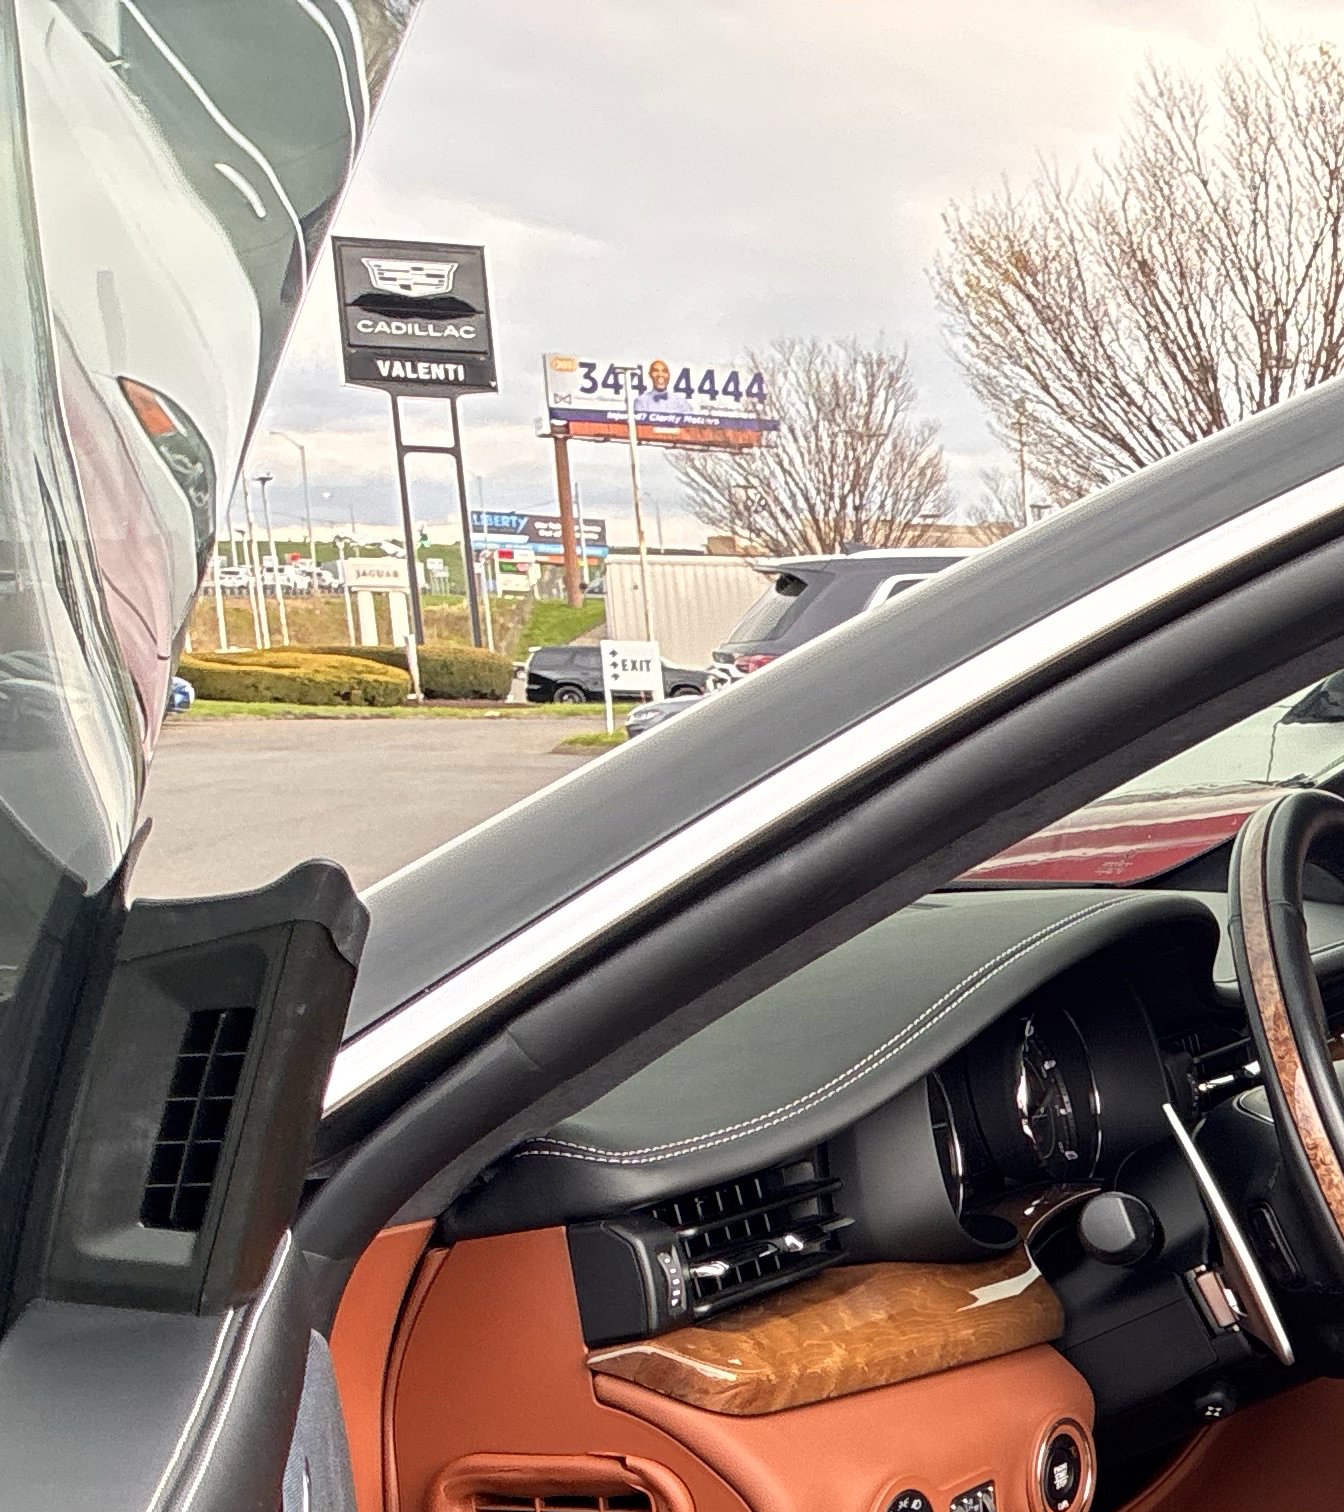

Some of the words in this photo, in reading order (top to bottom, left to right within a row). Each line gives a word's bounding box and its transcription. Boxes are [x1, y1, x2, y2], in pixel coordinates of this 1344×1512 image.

[356, 320, 476, 338] CADILLAC
[375, 359, 465, 381] VALENTI
[673, 367, 768, 404] 4444
[355, 569, 399, 579] JAGUAR
[621, 659, 651, 672] EXIT
